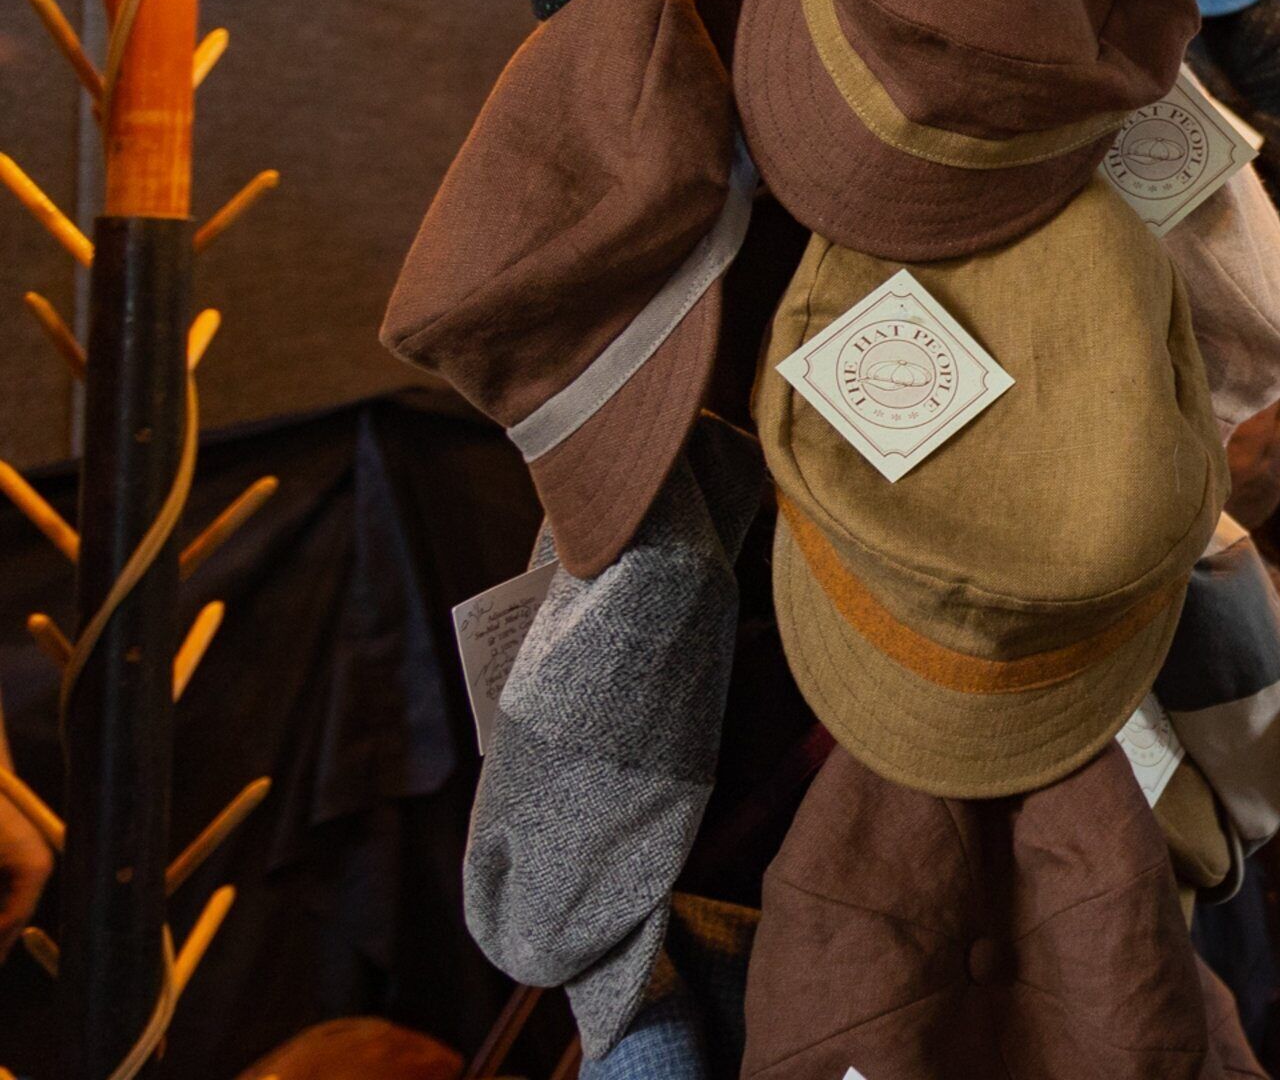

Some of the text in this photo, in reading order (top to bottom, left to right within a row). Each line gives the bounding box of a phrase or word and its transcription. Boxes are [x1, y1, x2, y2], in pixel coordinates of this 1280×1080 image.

[1169, 109, 1204, 185] PEOPLE
[843, 324, 954, 413] THE HAT PEOPLE
